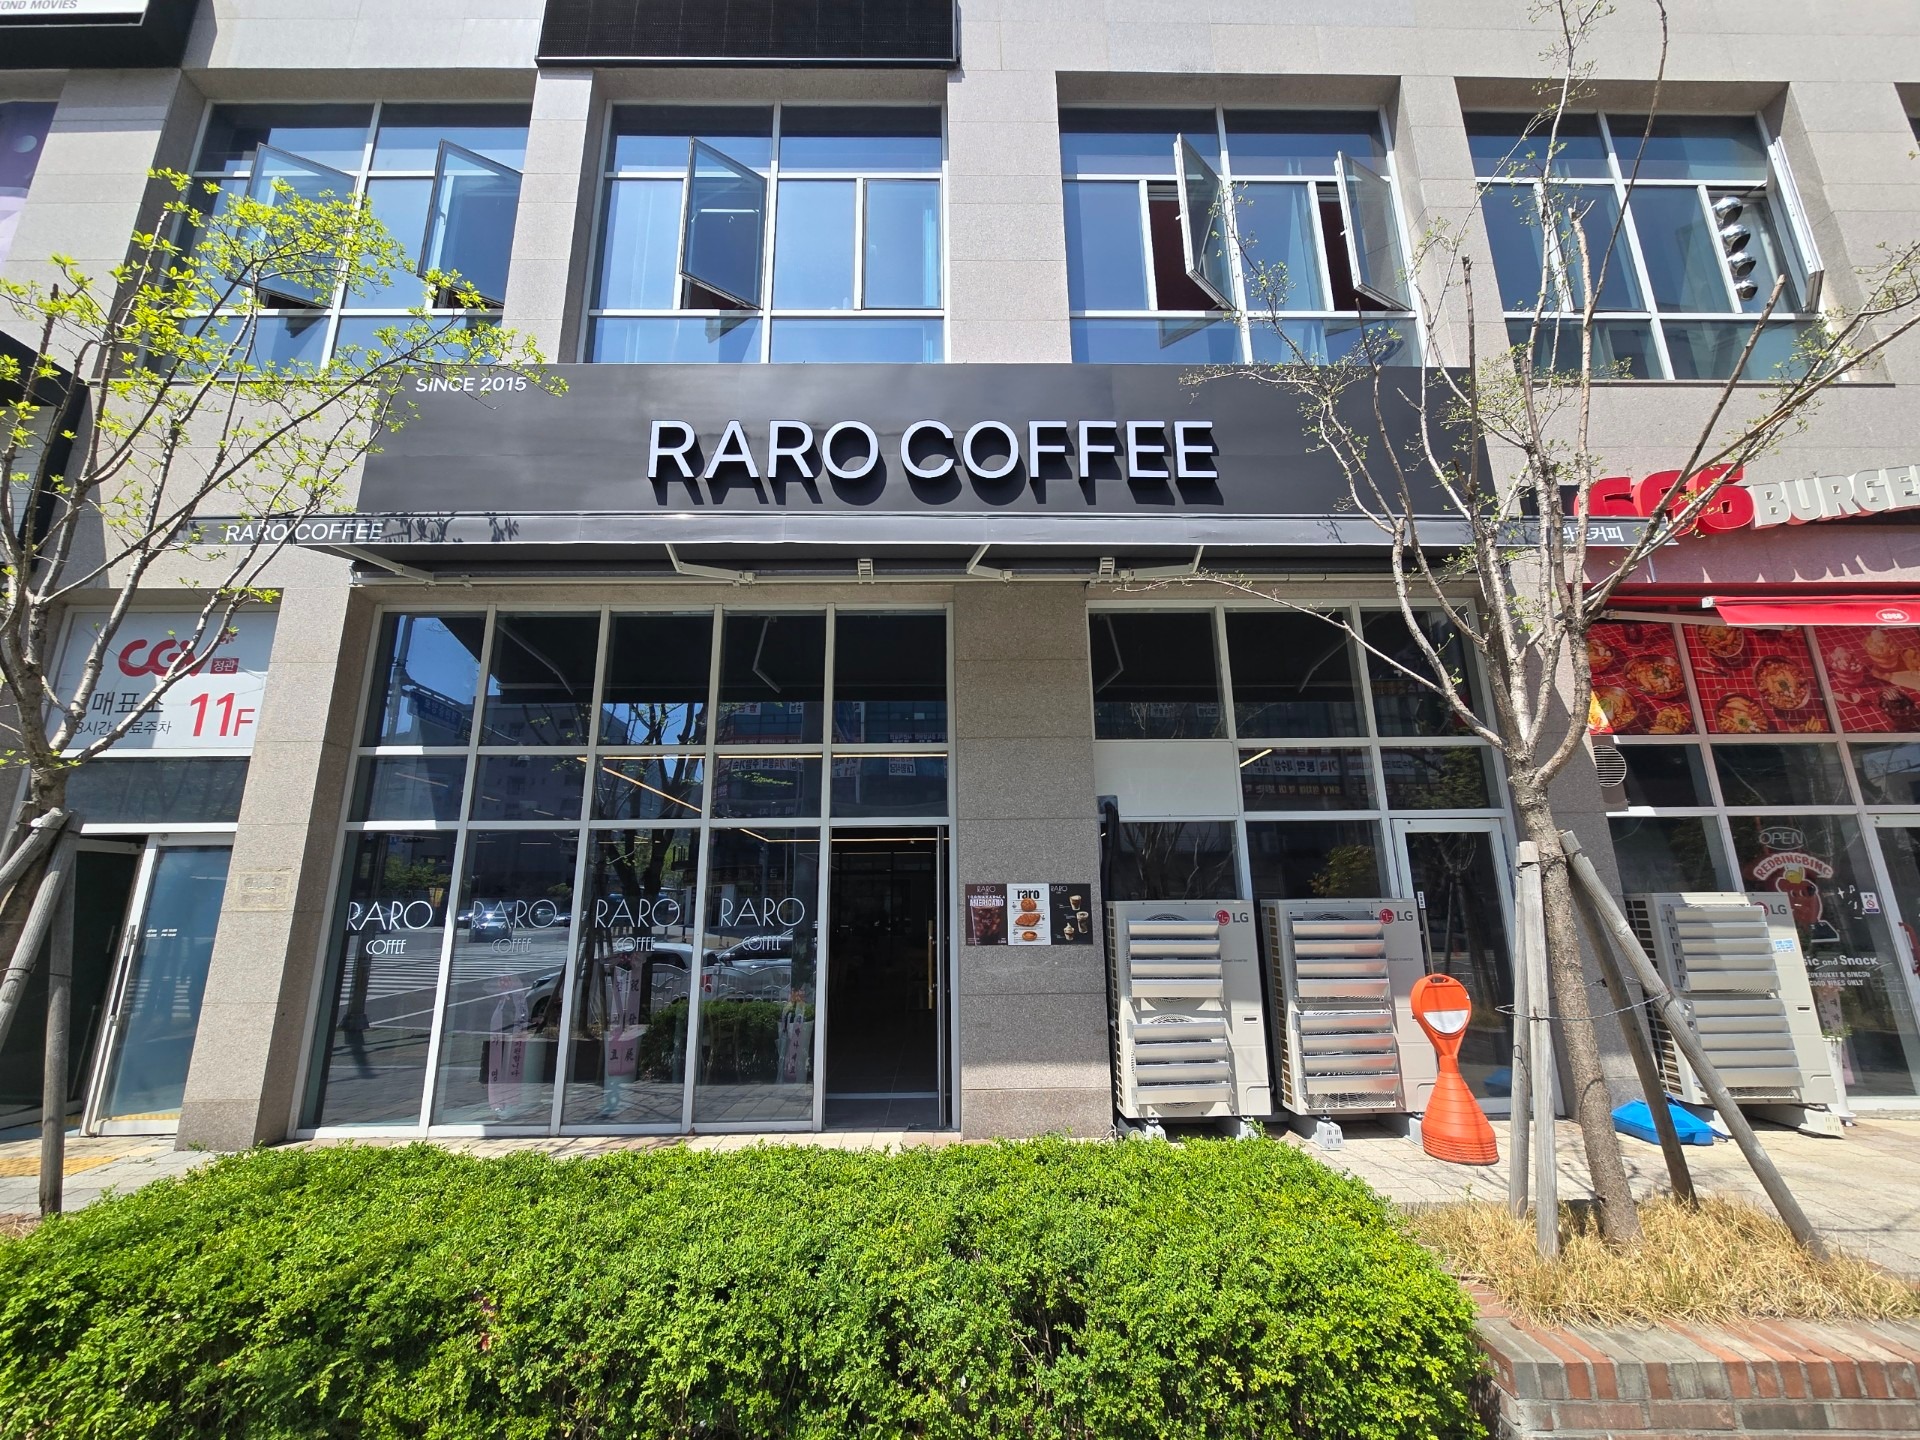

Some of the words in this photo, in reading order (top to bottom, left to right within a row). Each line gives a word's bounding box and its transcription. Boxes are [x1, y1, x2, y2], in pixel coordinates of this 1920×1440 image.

[30, 0, 78, 9] MOVIES
[415, 377, 476, 392] SINCE
[480, 376, 528, 391] 2015
[647, 419, 879, 480] RARO
[899, 418, 1219, 480] COFFEE
[1751, 464, 1920, 529] BURGE
[225, 523, 289, 542] RARO
[294, 522, 384, 541] COFFEE
[213, 658, 237, 673] 정관
[117, 720, 172, 736] 료주차
[1759, 831, 1804, 845] OPEN
[976, 885, 996, 893] RARO
[1017, 889, 1040, 900] raro
[345, 900, 433, 931] RARO
[471, 899, 557, 930] RARO
[594, 898, 680, 928] RARO
[720, 897, 805, 927] RARO
[1397, 910, 1414, 922] LG
[1770, 904, 1787, 915] LG
[1232, 913, 1249, 923] LG
[366, 939, 407, 955] COFFEE
[491, 937, 532, 954] COFFEE
[616, 936, 656, 952] COFFEE
[742, 935, 782, 951] COFFEE
[1822, 958, 1838, 966] and
[1840, 955, 1880, 966] Snack
